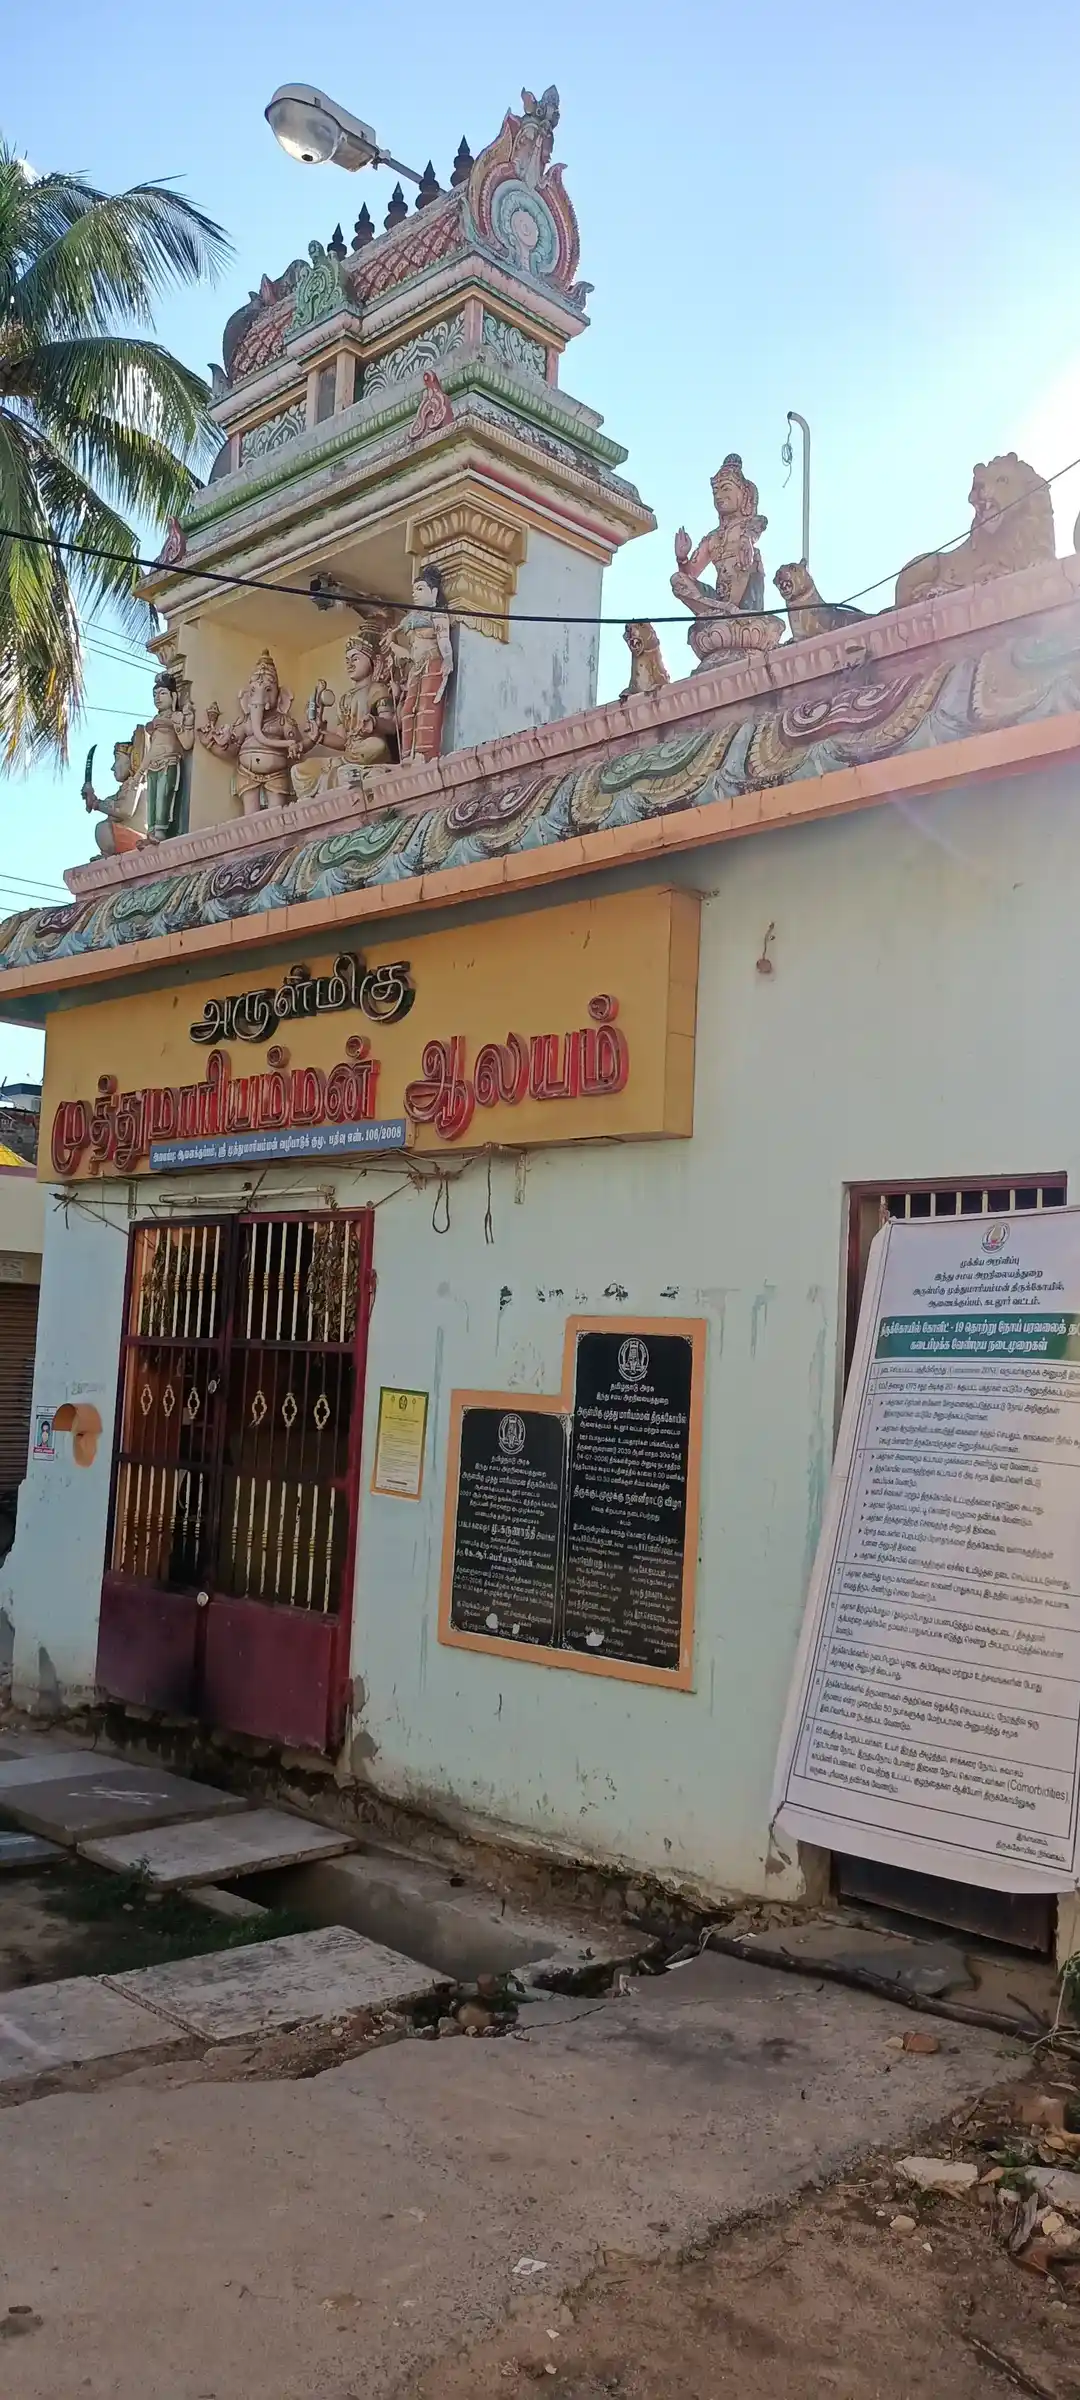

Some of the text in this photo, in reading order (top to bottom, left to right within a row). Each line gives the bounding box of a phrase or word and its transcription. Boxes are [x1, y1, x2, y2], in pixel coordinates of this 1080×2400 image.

[189, 952, 415, 1044] அருள்மிகு
[50, 994, 629, 1175] முத்துமாரியம்மன் ஆலயம்
[227, 1137, 278, 1156] முத்துமாரியம்மன்
[329, 1131, 345, 1148] பதிவு
[347, 1128, 364, 1142] எண்.
[960, 1256, 1019, 1268] முக்கிய அறிவிப்பு
[934, 1273, 954, 1282] இந்து
[975, 1269, 1043, 1281] அறநிலையத்துறை
[913, 1286, 945, 1296] அருள்மிகு
[947, 1282, 1010, 1295] முத்துமாரியம்மன்
[984, 1297, 1010, 1308] கடலூர்
[880, 1321, 921, 1337] திருக்கோயில்
[923, 1322, 948, 1334] கோவிட்
[955, 1322, 964, 1333] 19
[965, 1319, 996, 1336] தொற்று
[999, 1320, 1022, 1335] நோய்
[1024, 1319, 1067, 1335] பரவலைத்
[952, 1337, 986, 1351] வேண்டிய
[988, 1337, 1048, 1353] நடைமுறைகள்
[610, 1382, 654, 1393] தமிழ்நாடு அரசு
[596, 1392, 609, 1401] இந்து
[623, 1395, 669, 1405] அறநிலையத்துறை
[577, 1406, 686, 1426] அருள்மிகு முத்து மாரியம்மன் திருக்கோயில்
[665, 1497, 681, 1510] விழா
